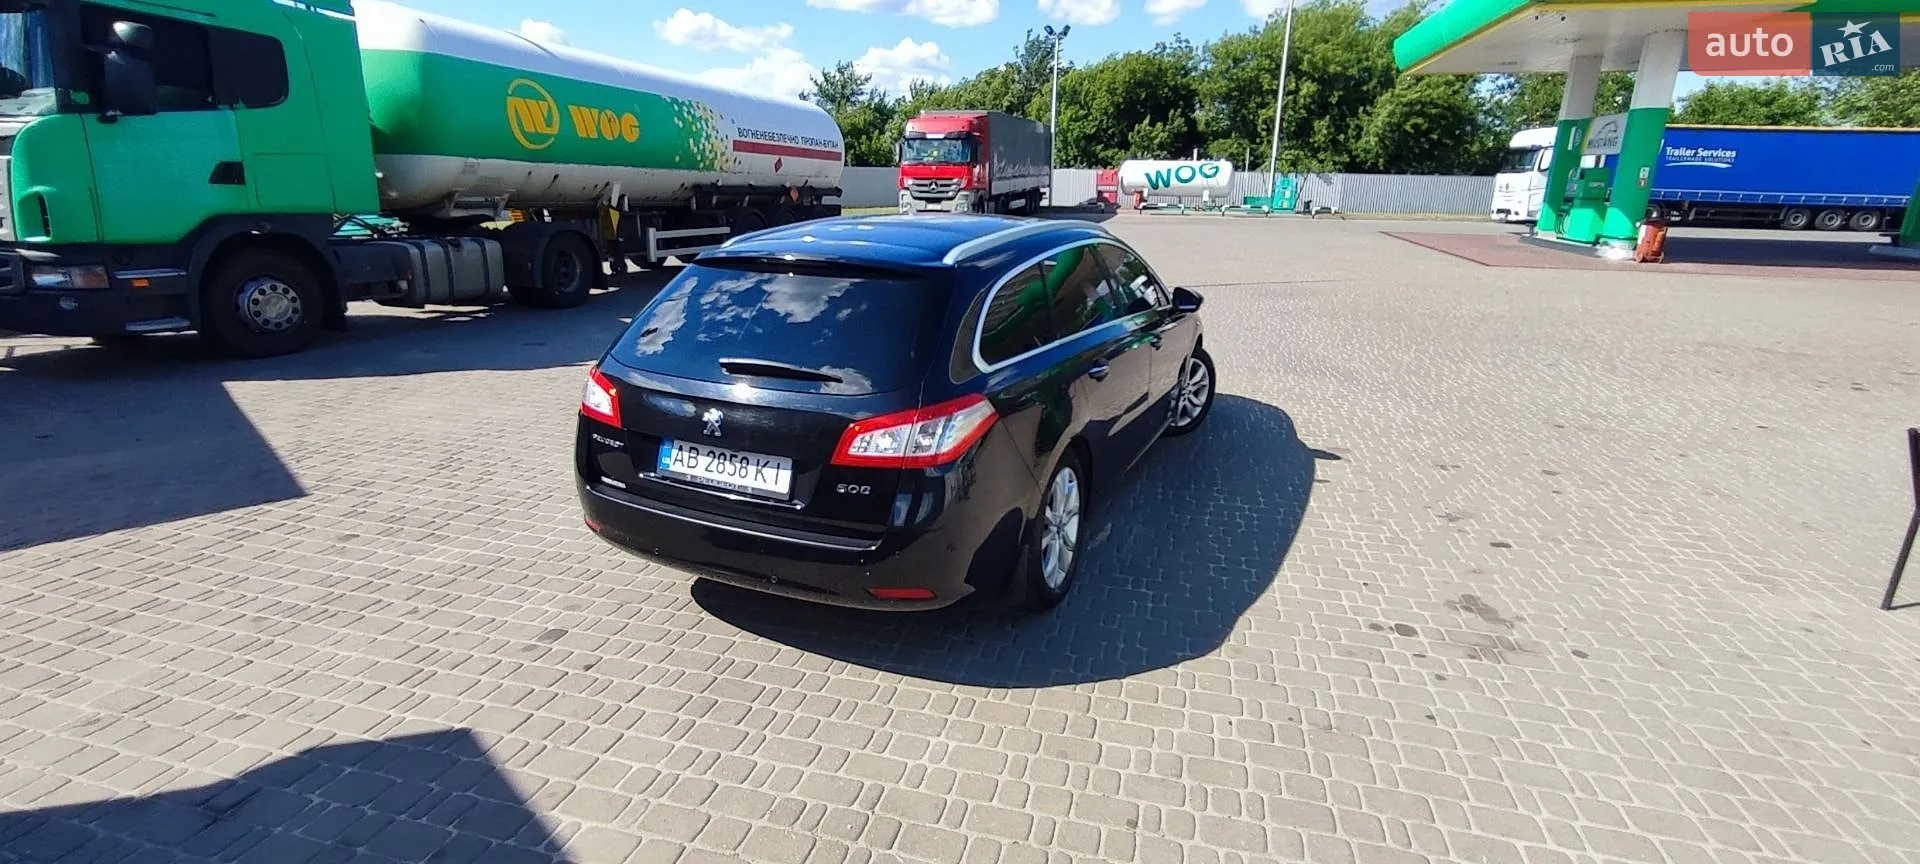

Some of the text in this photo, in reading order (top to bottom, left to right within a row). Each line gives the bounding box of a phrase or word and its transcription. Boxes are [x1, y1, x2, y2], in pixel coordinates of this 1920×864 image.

[568, 105, 641, 143] WOG
[737, 127, 799, 145] ВОГНЕНЕБЕЗПЕЧНО
[1666, 147, 1737, 158] Trailer Services
[1144, 163, 1220, 190] WOG
[673, 445, 700, 469] AB
[705, 450, 750, 479] 2858
[755, 458, 781, 486] KI
